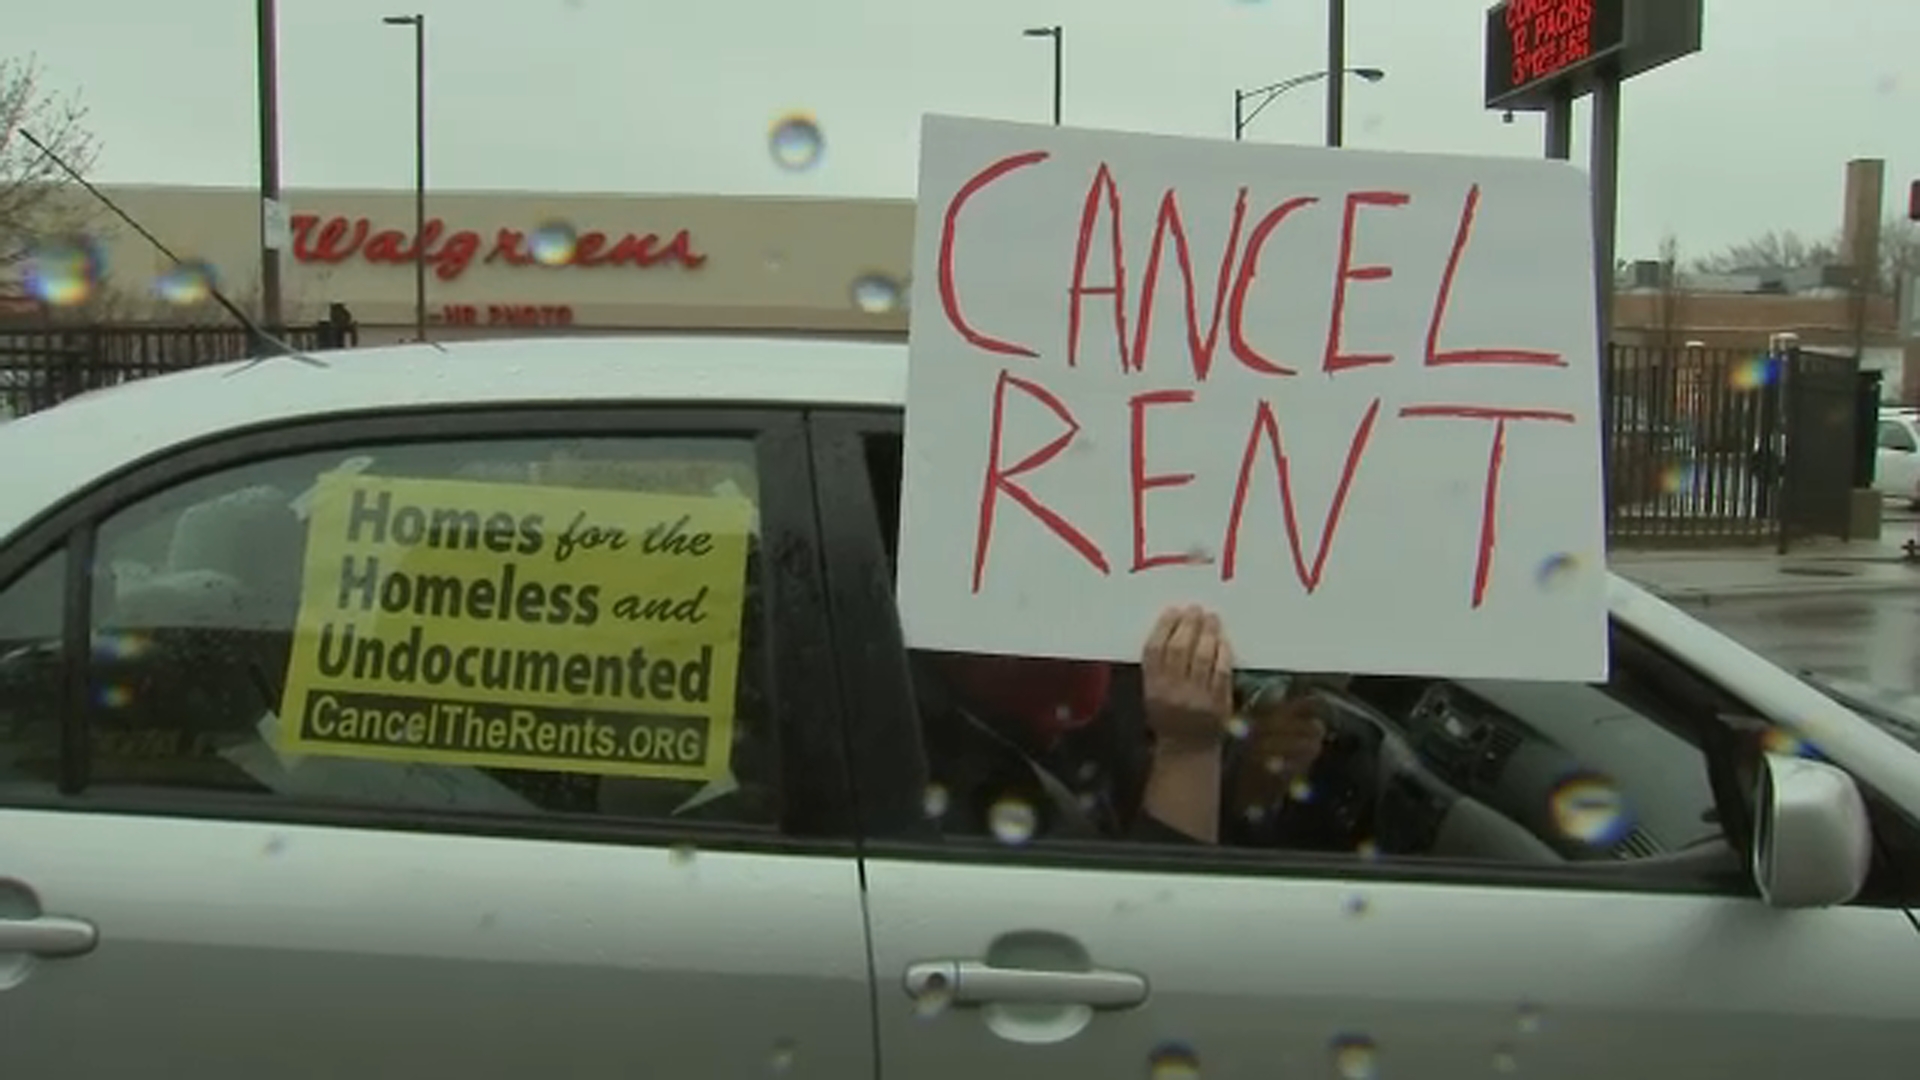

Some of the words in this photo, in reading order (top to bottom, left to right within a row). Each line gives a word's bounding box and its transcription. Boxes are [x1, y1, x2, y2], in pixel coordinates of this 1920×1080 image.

[290, 214, 707, 281] Walgrens
[938, 152, 1568, 381] CANCEL
[487, 304, 574, 326] PHOTO
[346, 488, 543, 554] Homes
[555, 511, 629, 562] for
[642, 515, 714, 557] the
[974, 369, 1575, 608] RENT
[337, 554, 599, 627] Homeless
[612, 586, 709, 624] and
[317, 622, 713, 703] Undocumented
[309, 696, 703, 762] CancelTheRents.ORG
